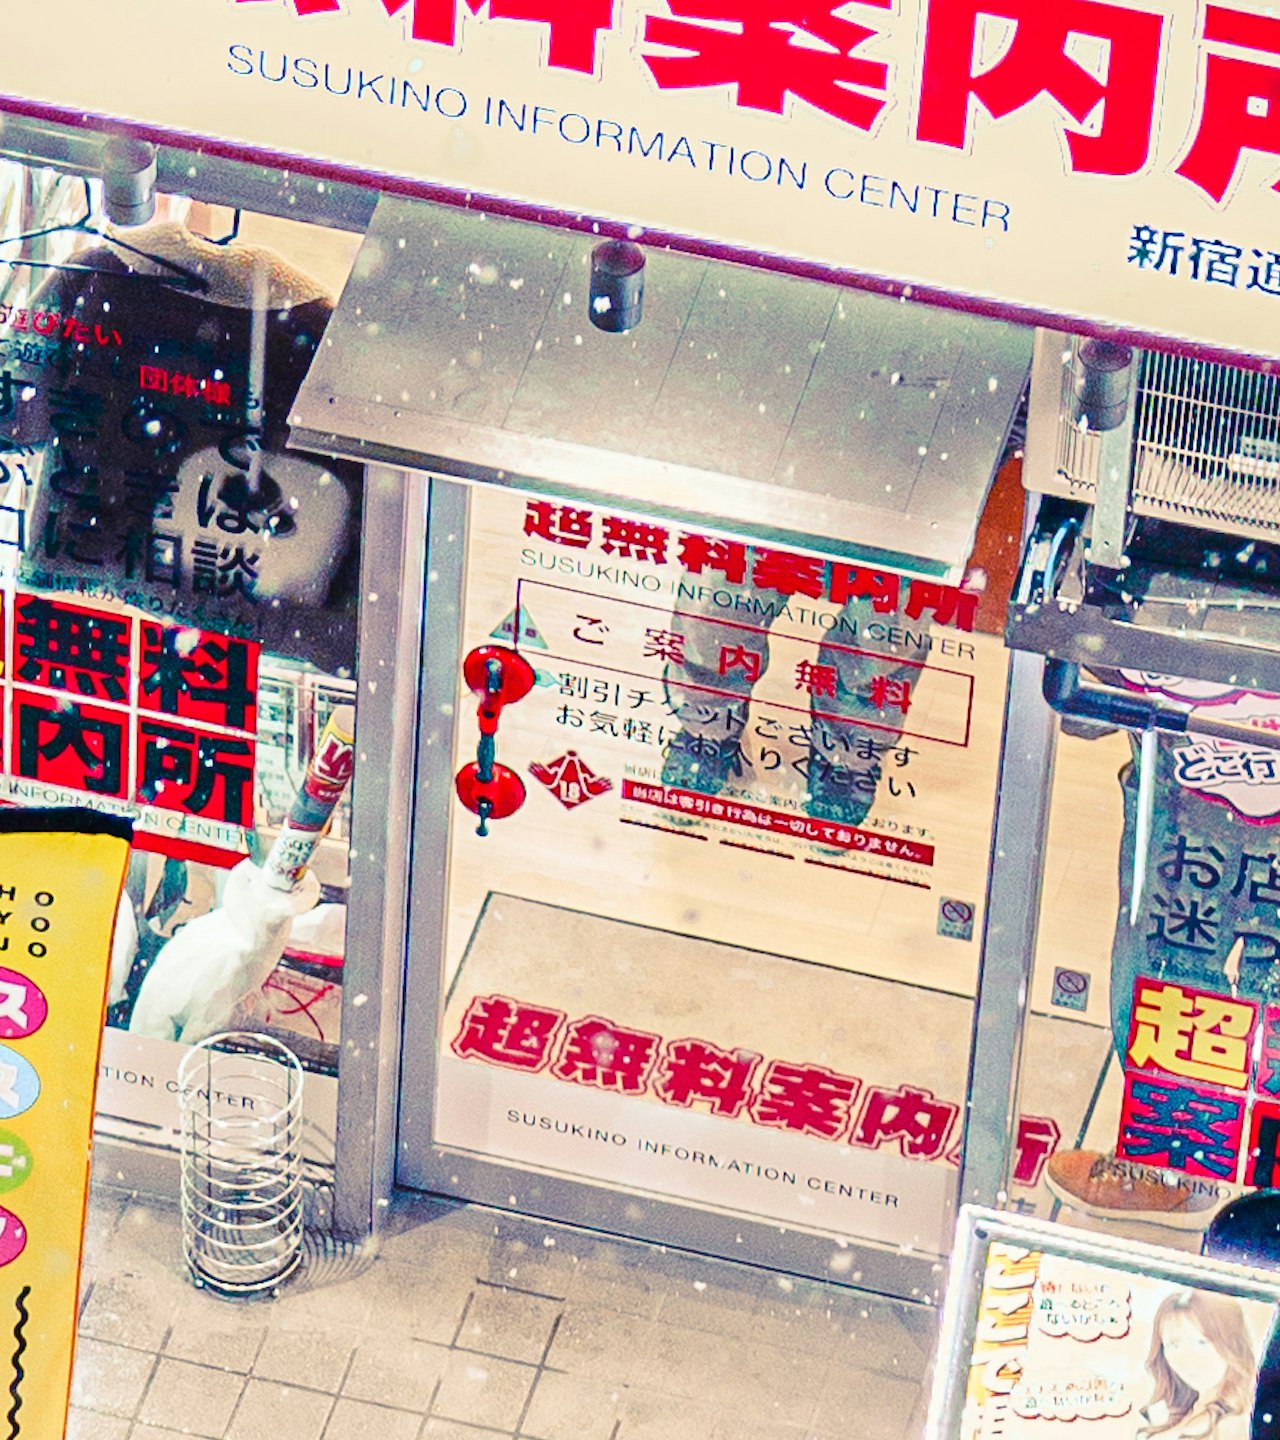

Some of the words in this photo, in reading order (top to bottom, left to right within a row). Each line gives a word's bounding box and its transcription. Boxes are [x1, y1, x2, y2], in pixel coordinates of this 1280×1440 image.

[225, 44, 467, 120] SUSUKINO
[484, 96, 807, 191] INFORMATION
[823, 167, 1012, 233] CENTER
[520, 548, 662, 593] SUSUKINO
[671, 578, 859, 637] INFORMATION
[868, 622, 976, 661] CENTER
[572, 613, 914, 715] ご案内無料
[506, 1108, 628, 1148] SUSUKINO
[636, 1138, 797, 1185] INFORMATION
[806, 1175, 900, 1209] CENTER
